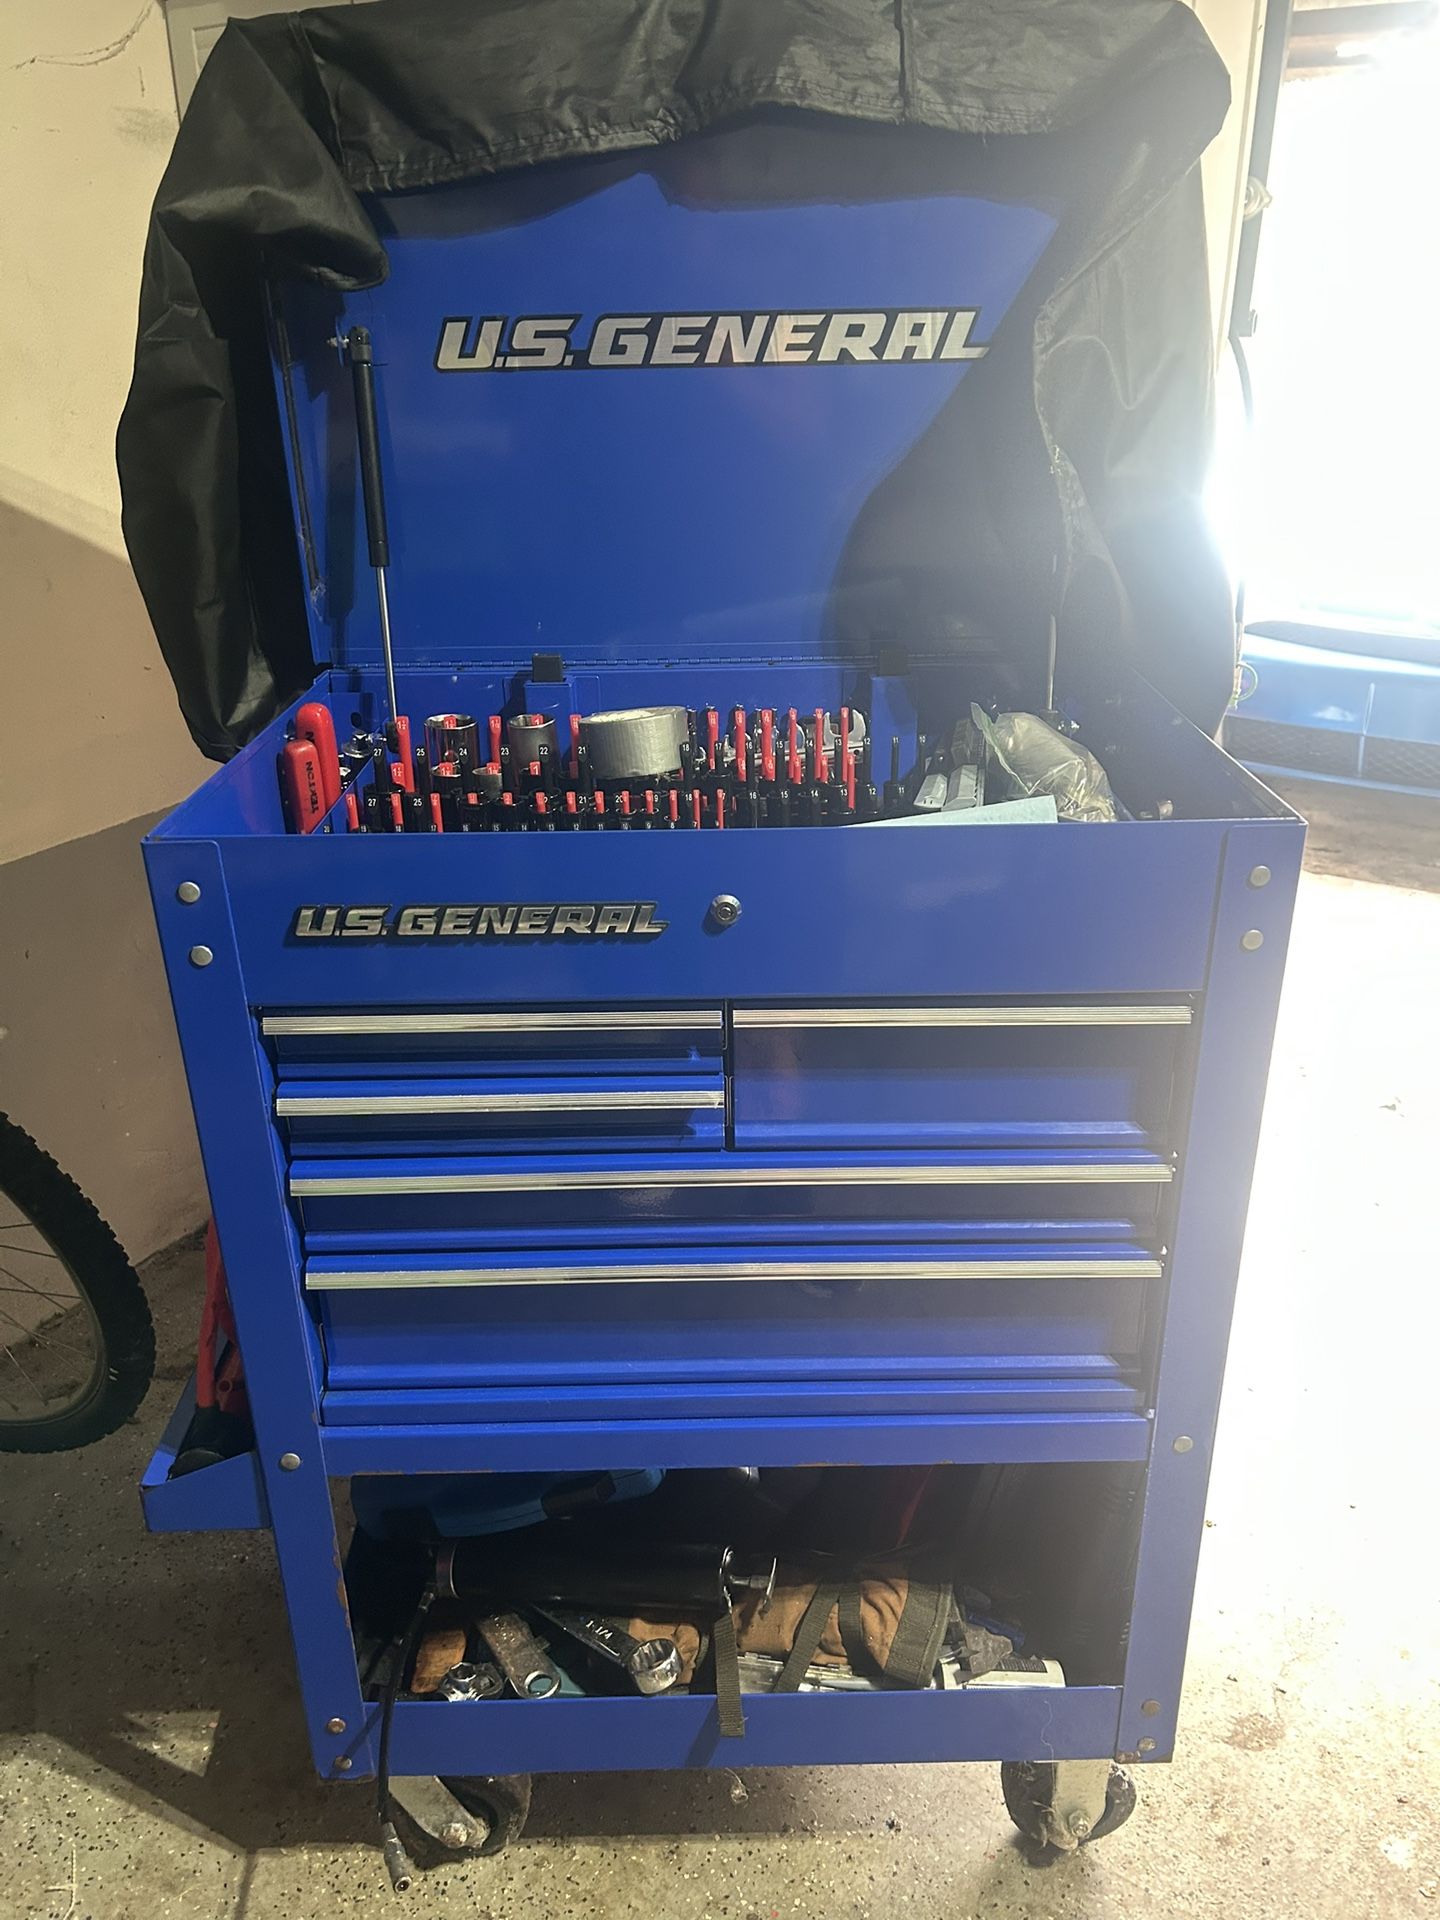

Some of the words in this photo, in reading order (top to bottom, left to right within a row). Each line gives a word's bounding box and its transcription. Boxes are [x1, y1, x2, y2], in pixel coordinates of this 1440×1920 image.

[745, 741, 753, 750] 16
[776, 741, 784, 749] 15
[806, 739, 814, 748] 14
[863, 737, 872, 745] 12
[539, 746, 549, 755] 22
[578, 746, 587, 755] 21
[682, 743, 690, 752] 18
[715, 742, 722, 751] 17
[373, 748, 382, 756] 27
[416, 748, 426, 756] 25
[459, 748, 468, 756] 24
[500, 747, 510, 756] 23
[749, 791, 757, 800] 16
[780, 791, 788, 799] 15
[810, 789, 819, 798] 14
[840, 788, 848, 797] 13
[868, 787, 876, 796] 12
[578, 795, 587, 804] 21
[685, 793, 693, 802] 18
[367, 798, 377, 807] 27
[413, 798, 423, 807] 25
